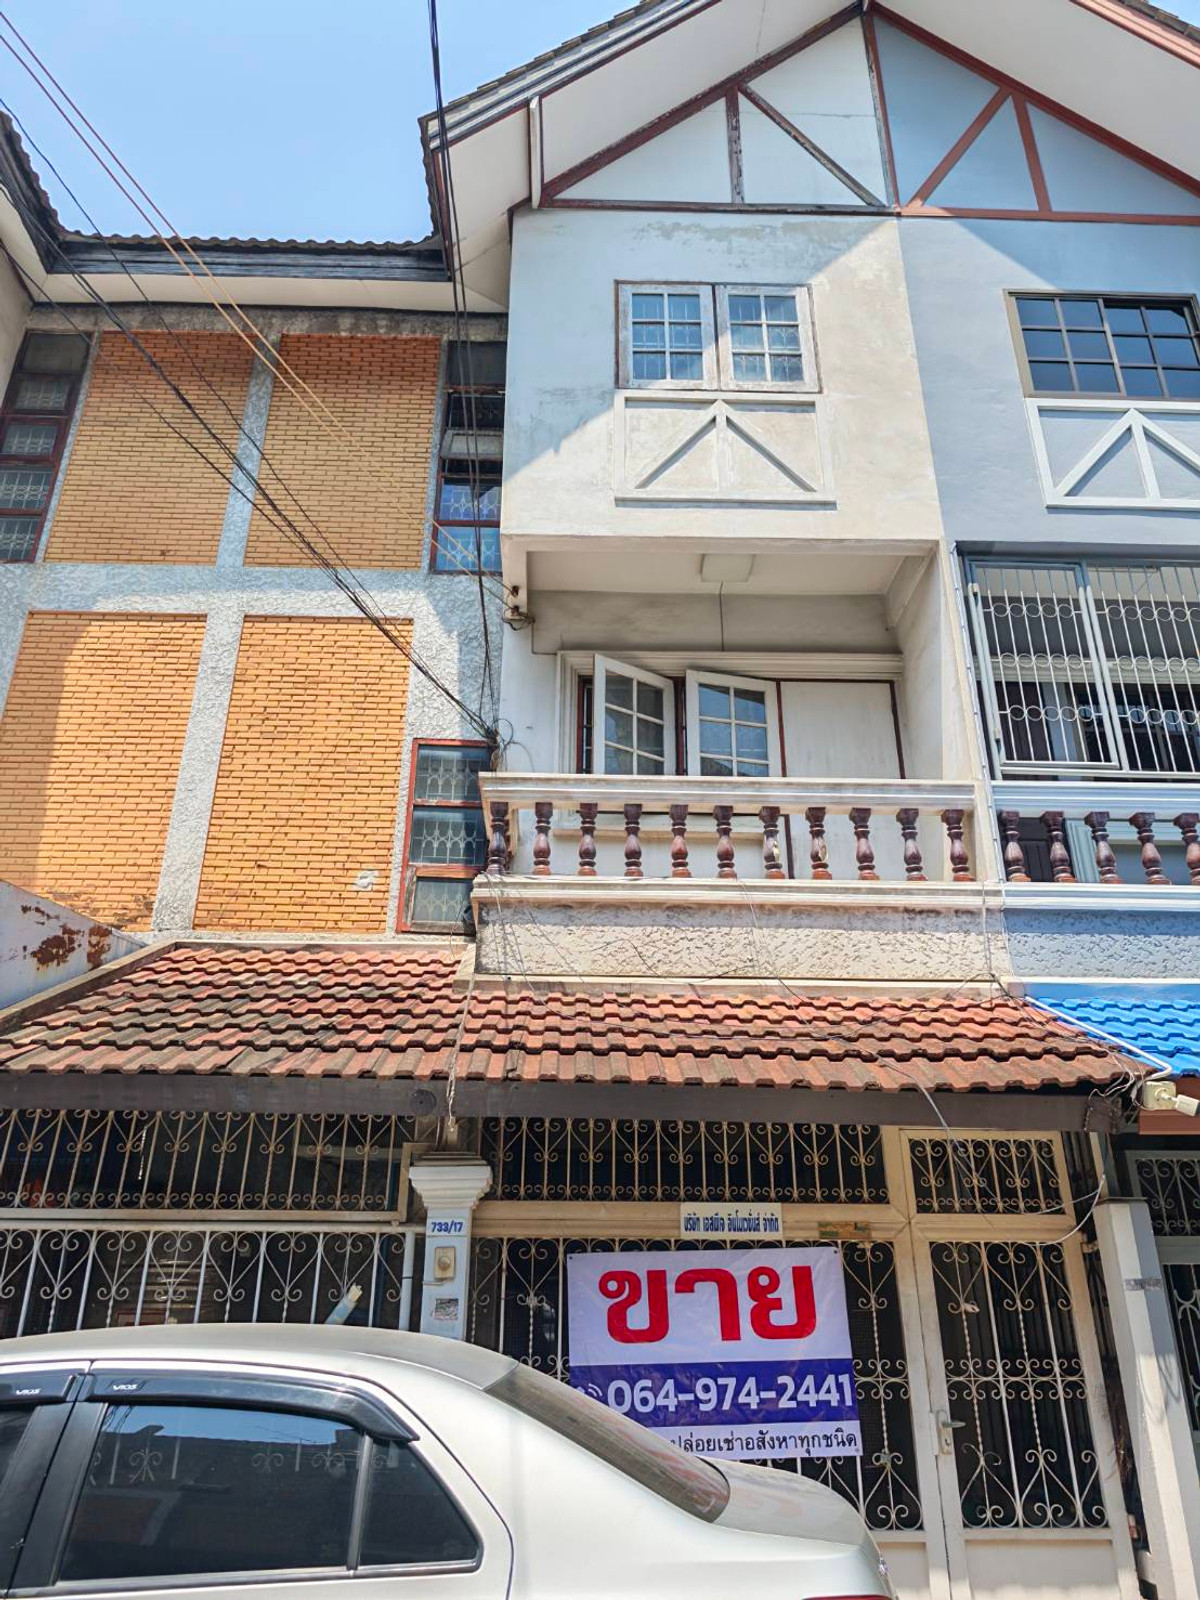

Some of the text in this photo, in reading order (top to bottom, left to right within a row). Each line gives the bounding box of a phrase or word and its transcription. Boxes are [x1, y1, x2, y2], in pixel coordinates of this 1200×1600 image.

[431, 1220, 464, 1234] 733/17
[684, 1211, 701, 1232] บริษัท
[762, 1212, 780, 1232] จำกัด
[598, 1265, 817, 1343] ขาย
[607, 1373, 853, 1414] 064-974-2441
